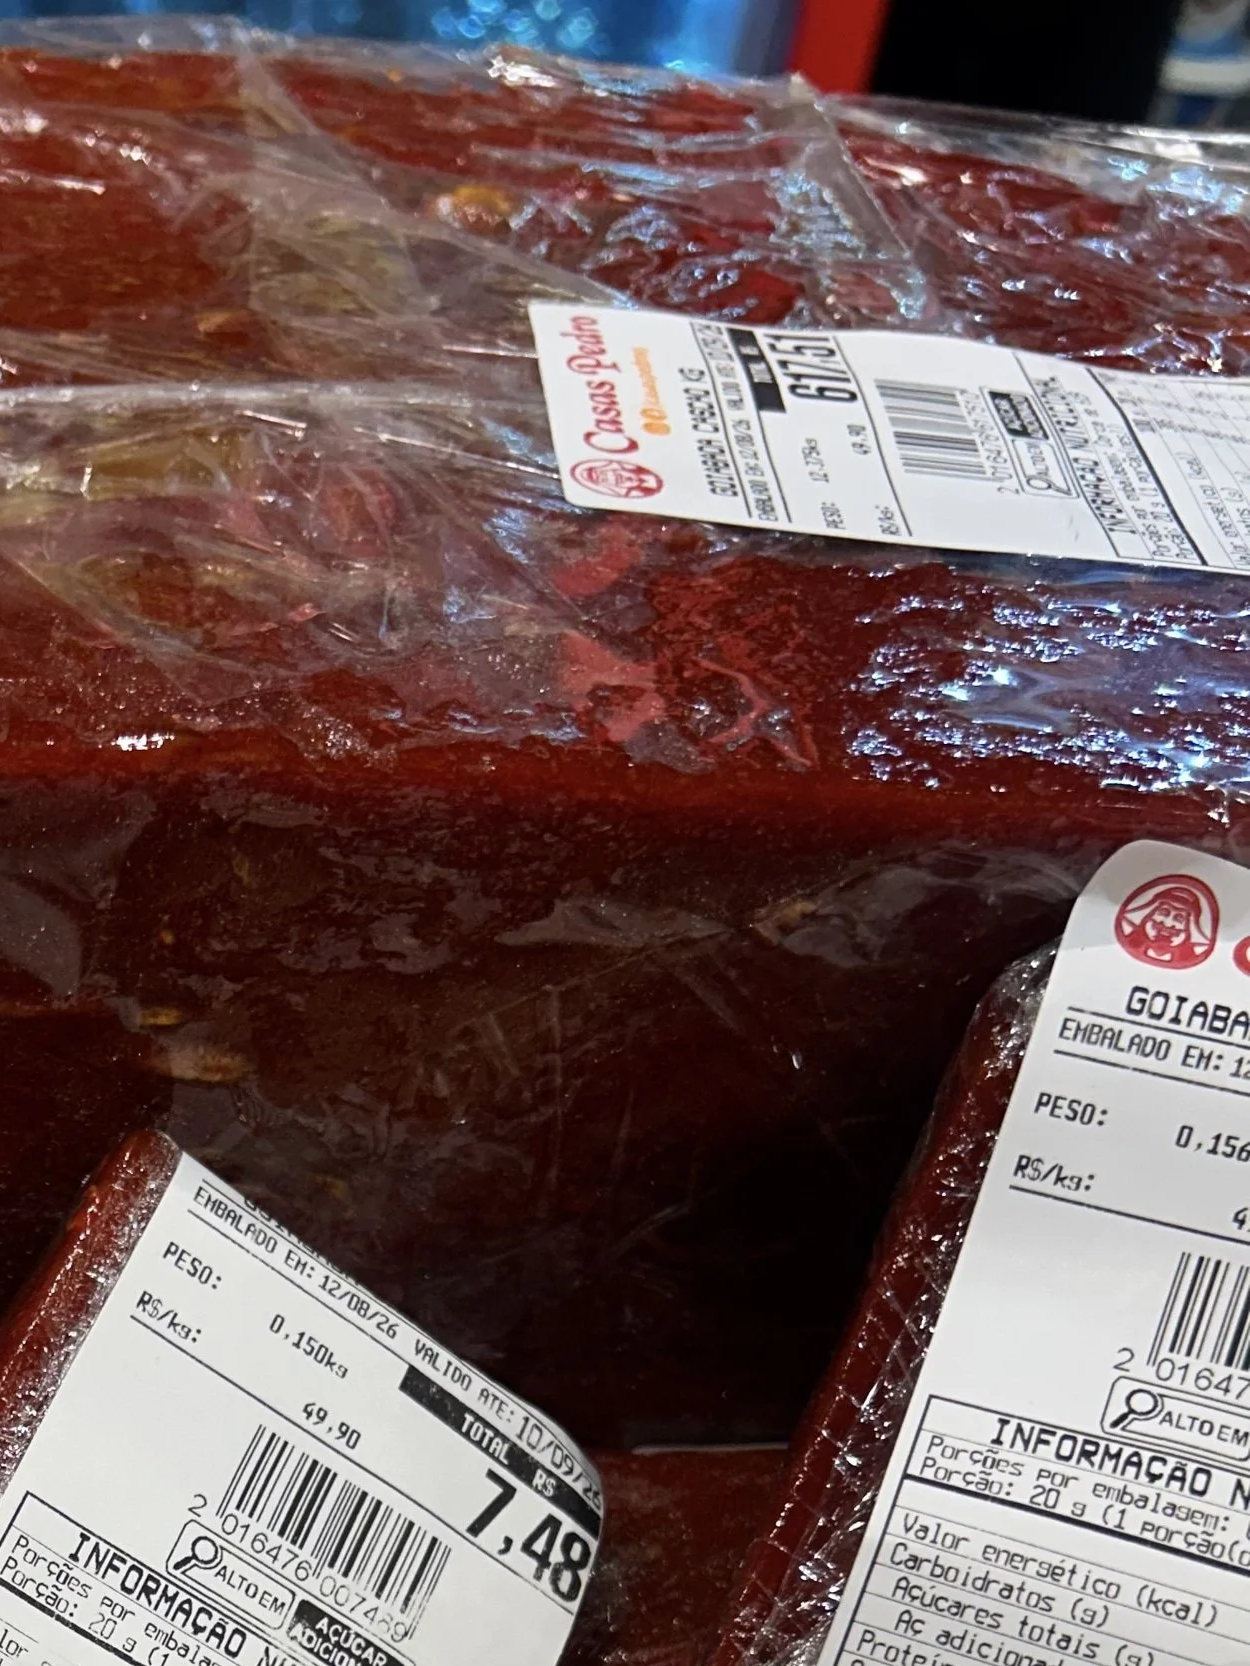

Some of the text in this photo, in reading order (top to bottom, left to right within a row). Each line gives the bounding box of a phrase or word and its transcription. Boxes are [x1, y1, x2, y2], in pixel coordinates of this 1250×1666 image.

[560, 315, 640, 455] Casas Pedro
[678, 367, 706, 383] KG
[764, 334, 858, 403] 617,51
[697, 439, 739, 497] GOIABADA
[1059, 1018, 1223, 1071] EMBALADO EM:
[1034, 1092, 1109, 1126] PESO:
[1013, 1154, 1095, 1192] R$/kg:
[162, 1241, 349, 1379] PESO: 0,150kg
[193, 1185, 278, 1254] EMBALADO
[284, 1248, 315, 1279] EM:
[318, 1274, 400, 1340] 12/08/26
[414, 1338, 473, 1392] VALIDO
[477, 1387, 515, 1423] ATE:
[136, 1290, 362, 1450] R$/kg: 49,90
[461, 1412, 556, 1497] TOTAL R$
[990, 1417, 1213, 1498] INFORMAÇÃO
[1158, 1407, 1215, 1437] ALTO
[926, 1434, 1230, 1532] Porções embalagem:
[11, 1534, 93, 1599] Porções
[187, 1493, 208, 1518] 2
[221, 1512, 313, 1582] 016476
[459, 1464, 601, 1608] 7,48
[889, 1541, 1056, 1613] Carboidratos
[903, 1512, 1218, 1628] Valor energético (kcal)
[68, 1531, 247, 1659] INFORMAÇÃO
[213, 1560, 286, 1616] ALTO EM
[891, 1575, 1101, 1660] Açúcares totais
